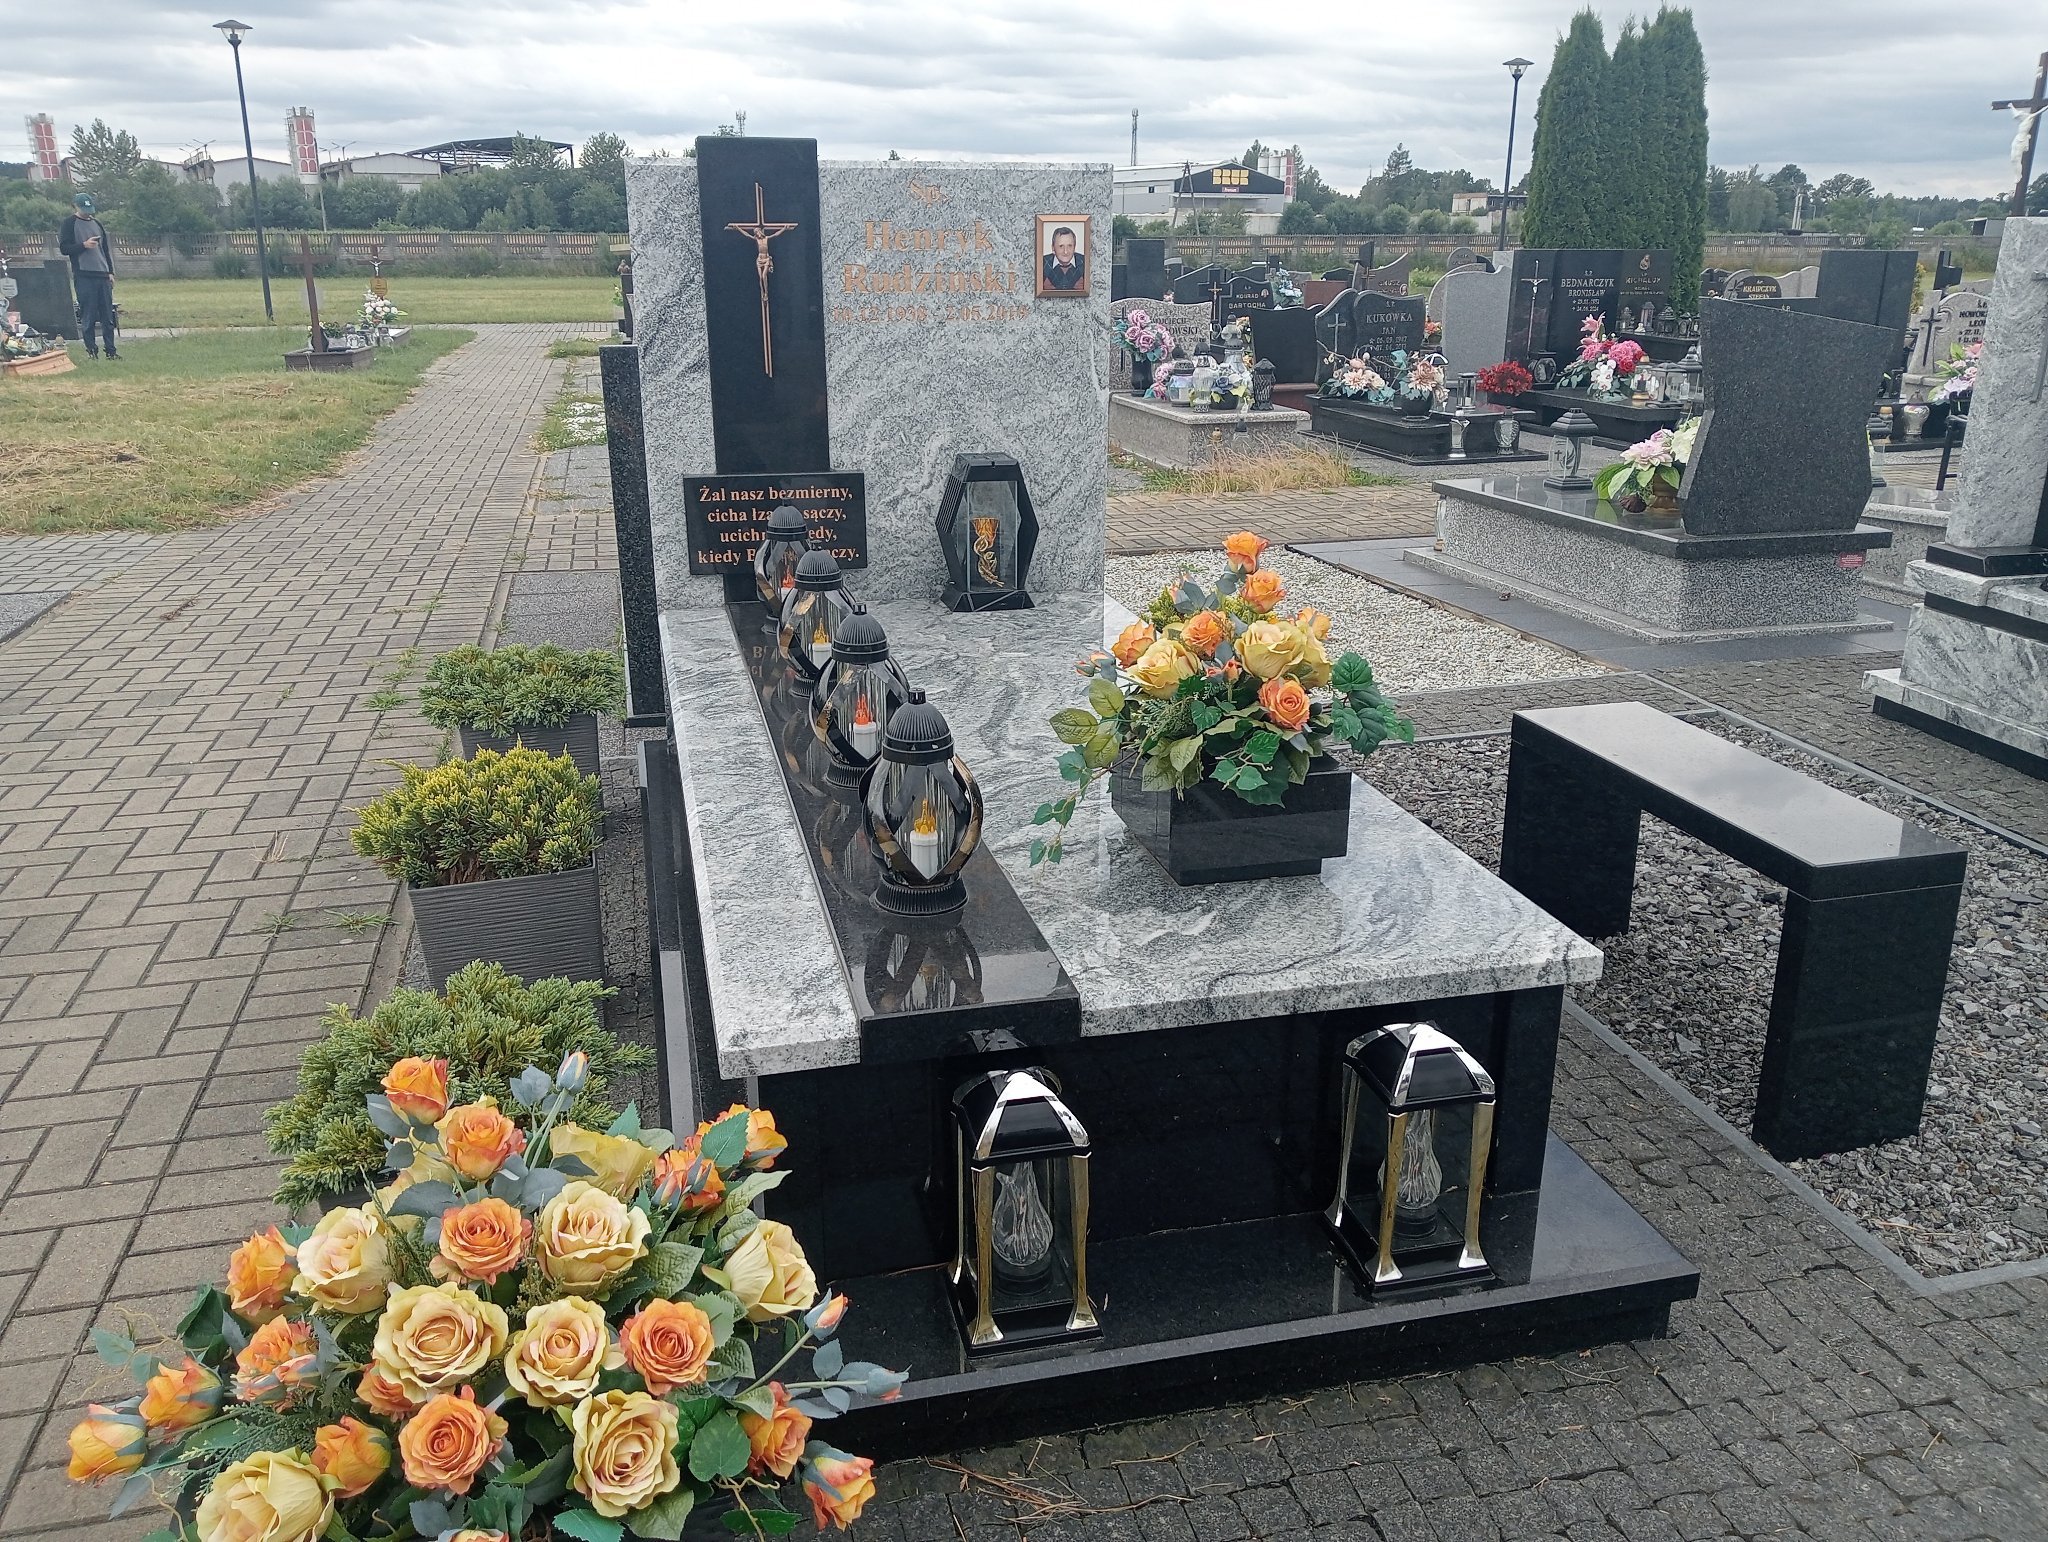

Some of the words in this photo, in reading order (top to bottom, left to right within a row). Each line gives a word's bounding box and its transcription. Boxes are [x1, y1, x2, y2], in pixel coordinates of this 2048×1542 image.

[864, 219, 993, 260] Henryk
[1561, 278, 1615, 288] BEDNARCZYK
[1366, 312, 1413, 323] KUKOWKA
[1168, 326, 1199, 335] OWSKI
[1381, 327, 1396, 335] JAN
[699, 485, 726, 502] Żal
[731, 489, 765, 501] nasz
[768, 485, 853, 501] bezmierny,
[707, 508, 748, 523] cicha
[803, 507, 847, 522] sączy,
[808, 526, 837, 542] edy,
[698, 550, 741, 566] kiedy
